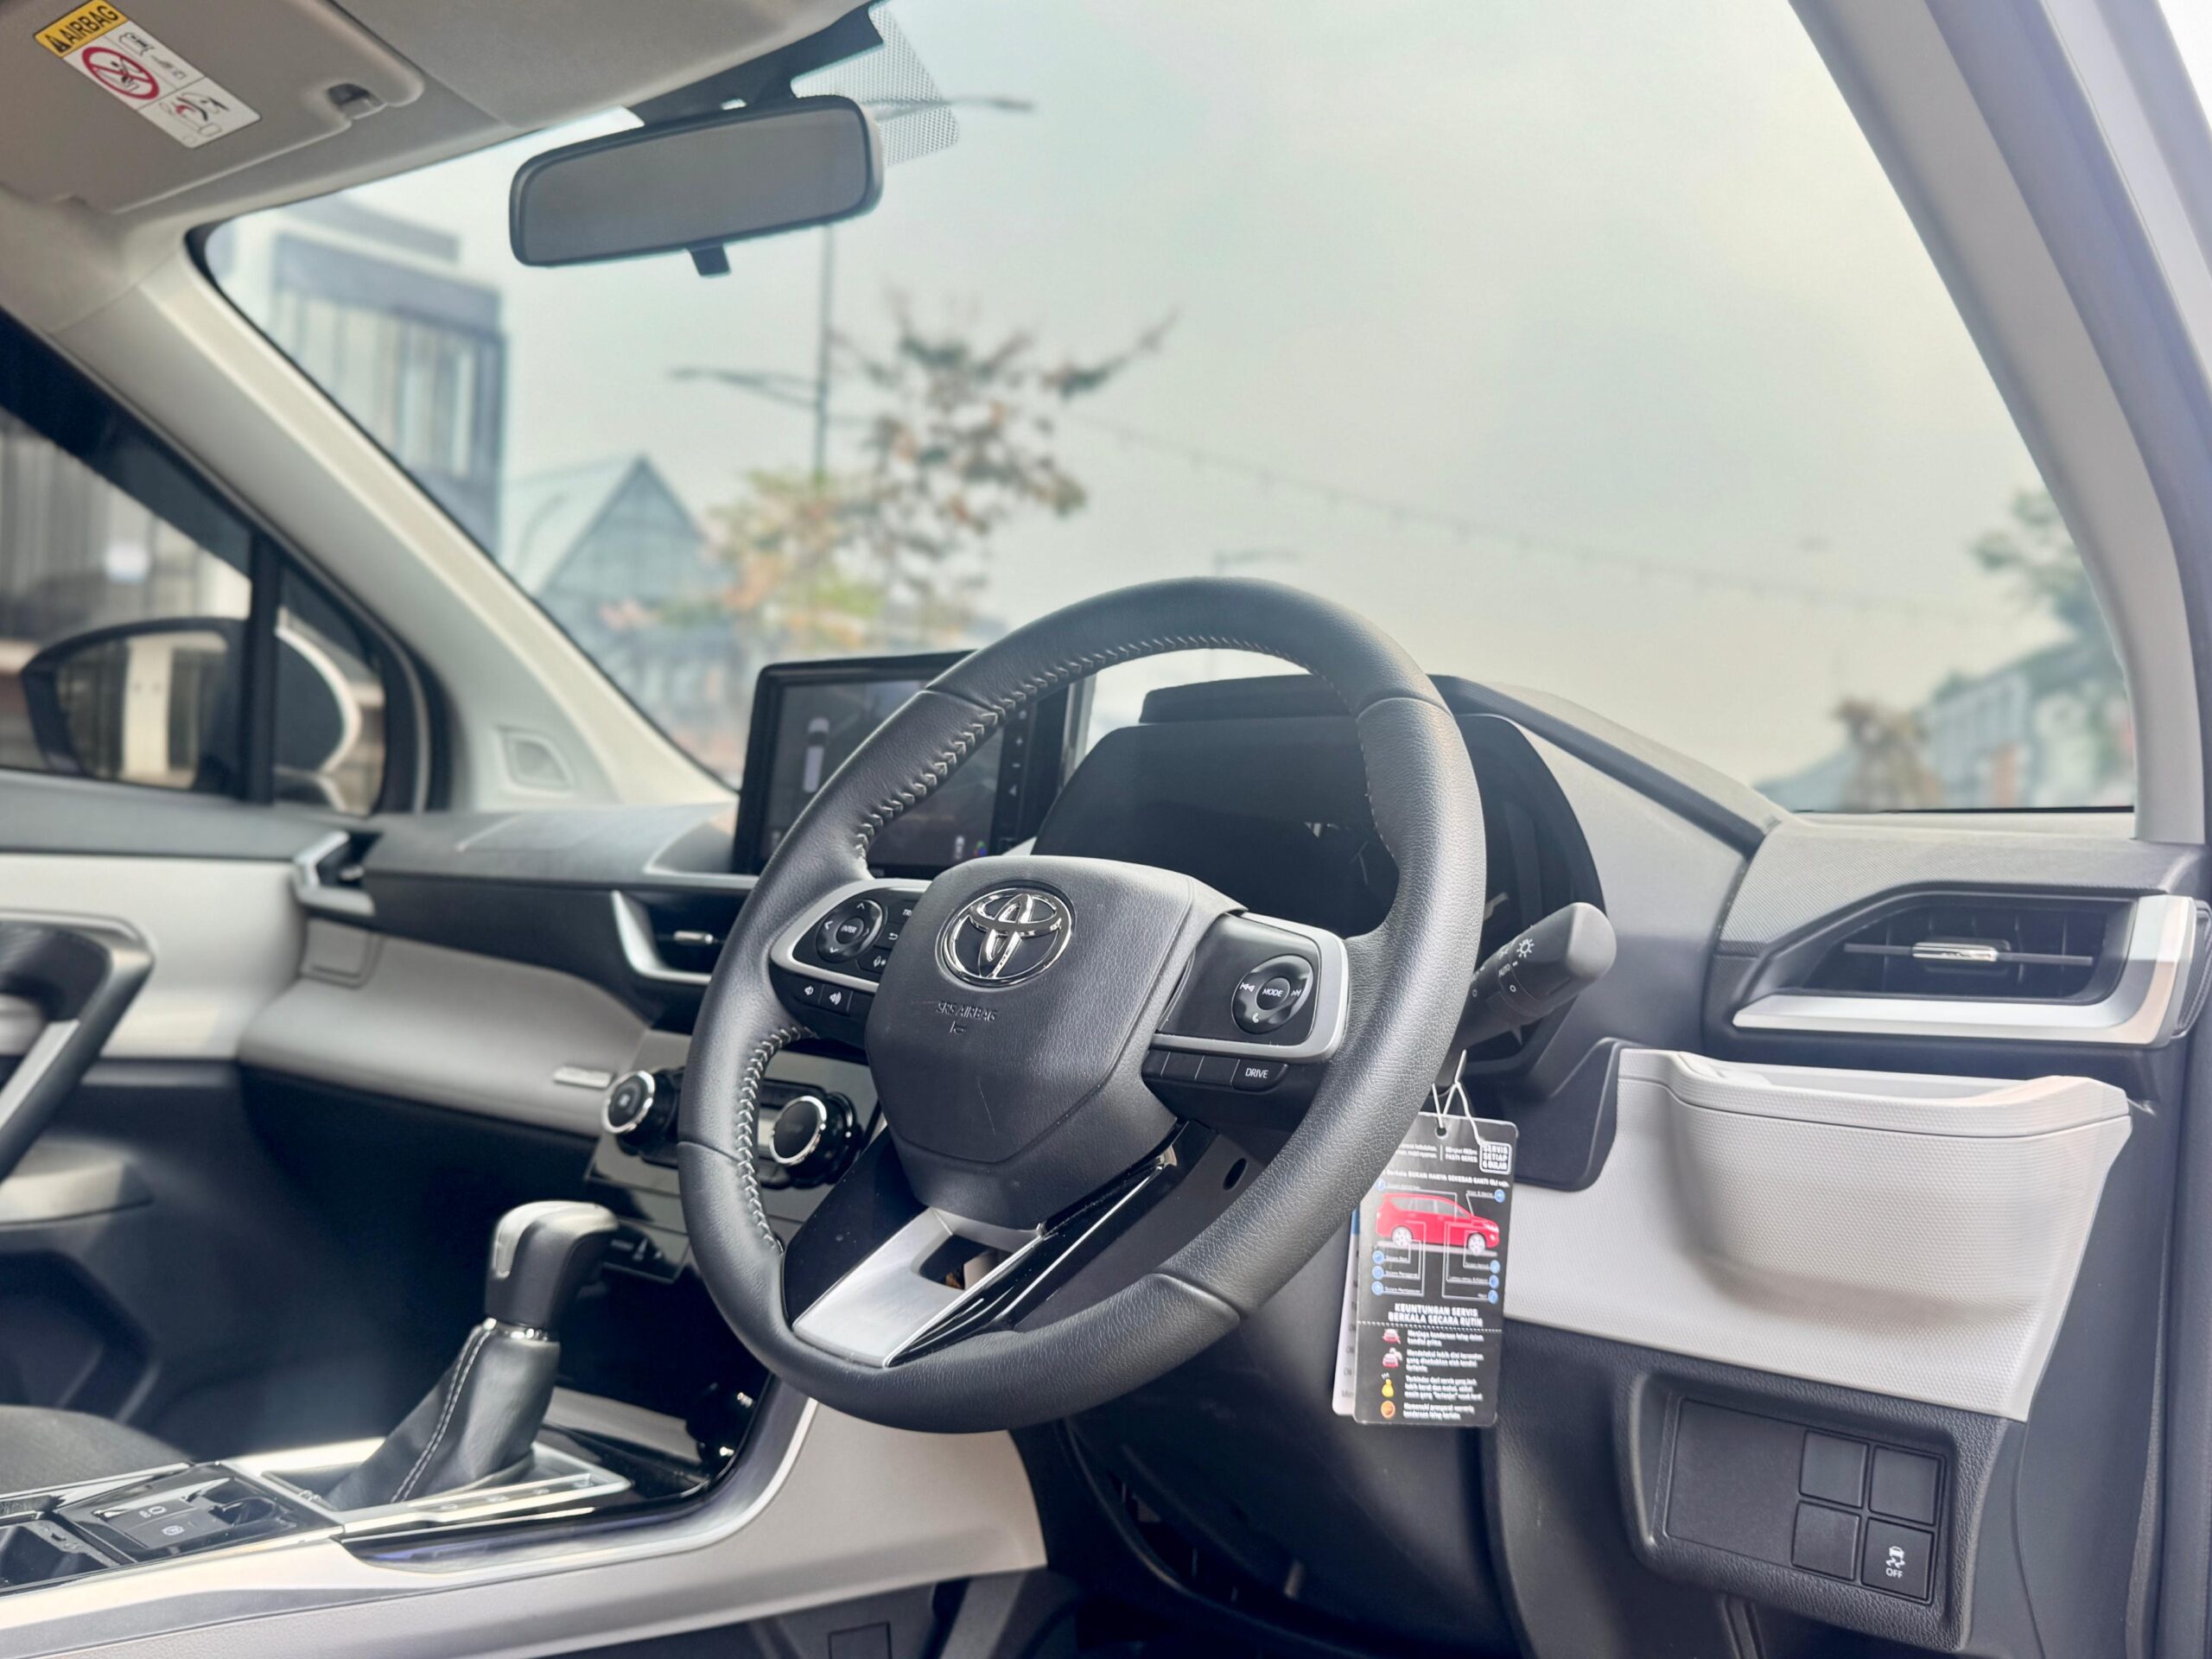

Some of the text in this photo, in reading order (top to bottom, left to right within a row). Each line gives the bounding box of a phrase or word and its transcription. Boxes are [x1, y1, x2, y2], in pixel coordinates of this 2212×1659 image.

[59, 4, 119, 44] AIRBAG
[841, 925, 857, 933] ENTER
[1498, 963, 1510, 977] AUTO
[1262, 988, 1283, 997] MODE
[936, 1001, 997, 1022] SRS AIRBAG
[1245, 1067, 1268, 1079] DRIVE
[1483, 1152, 1508, 1162] SETIAP
[1428, 1173, 1448, 1181] HANYA
[1394, 1303, 1479, 1318] KEUNTUNGAN SERVIS
[1388, 1311, 1484, 1327] BERKALA SECARA RUTIN
[1885, 1567, 1903, 1578] OFF
